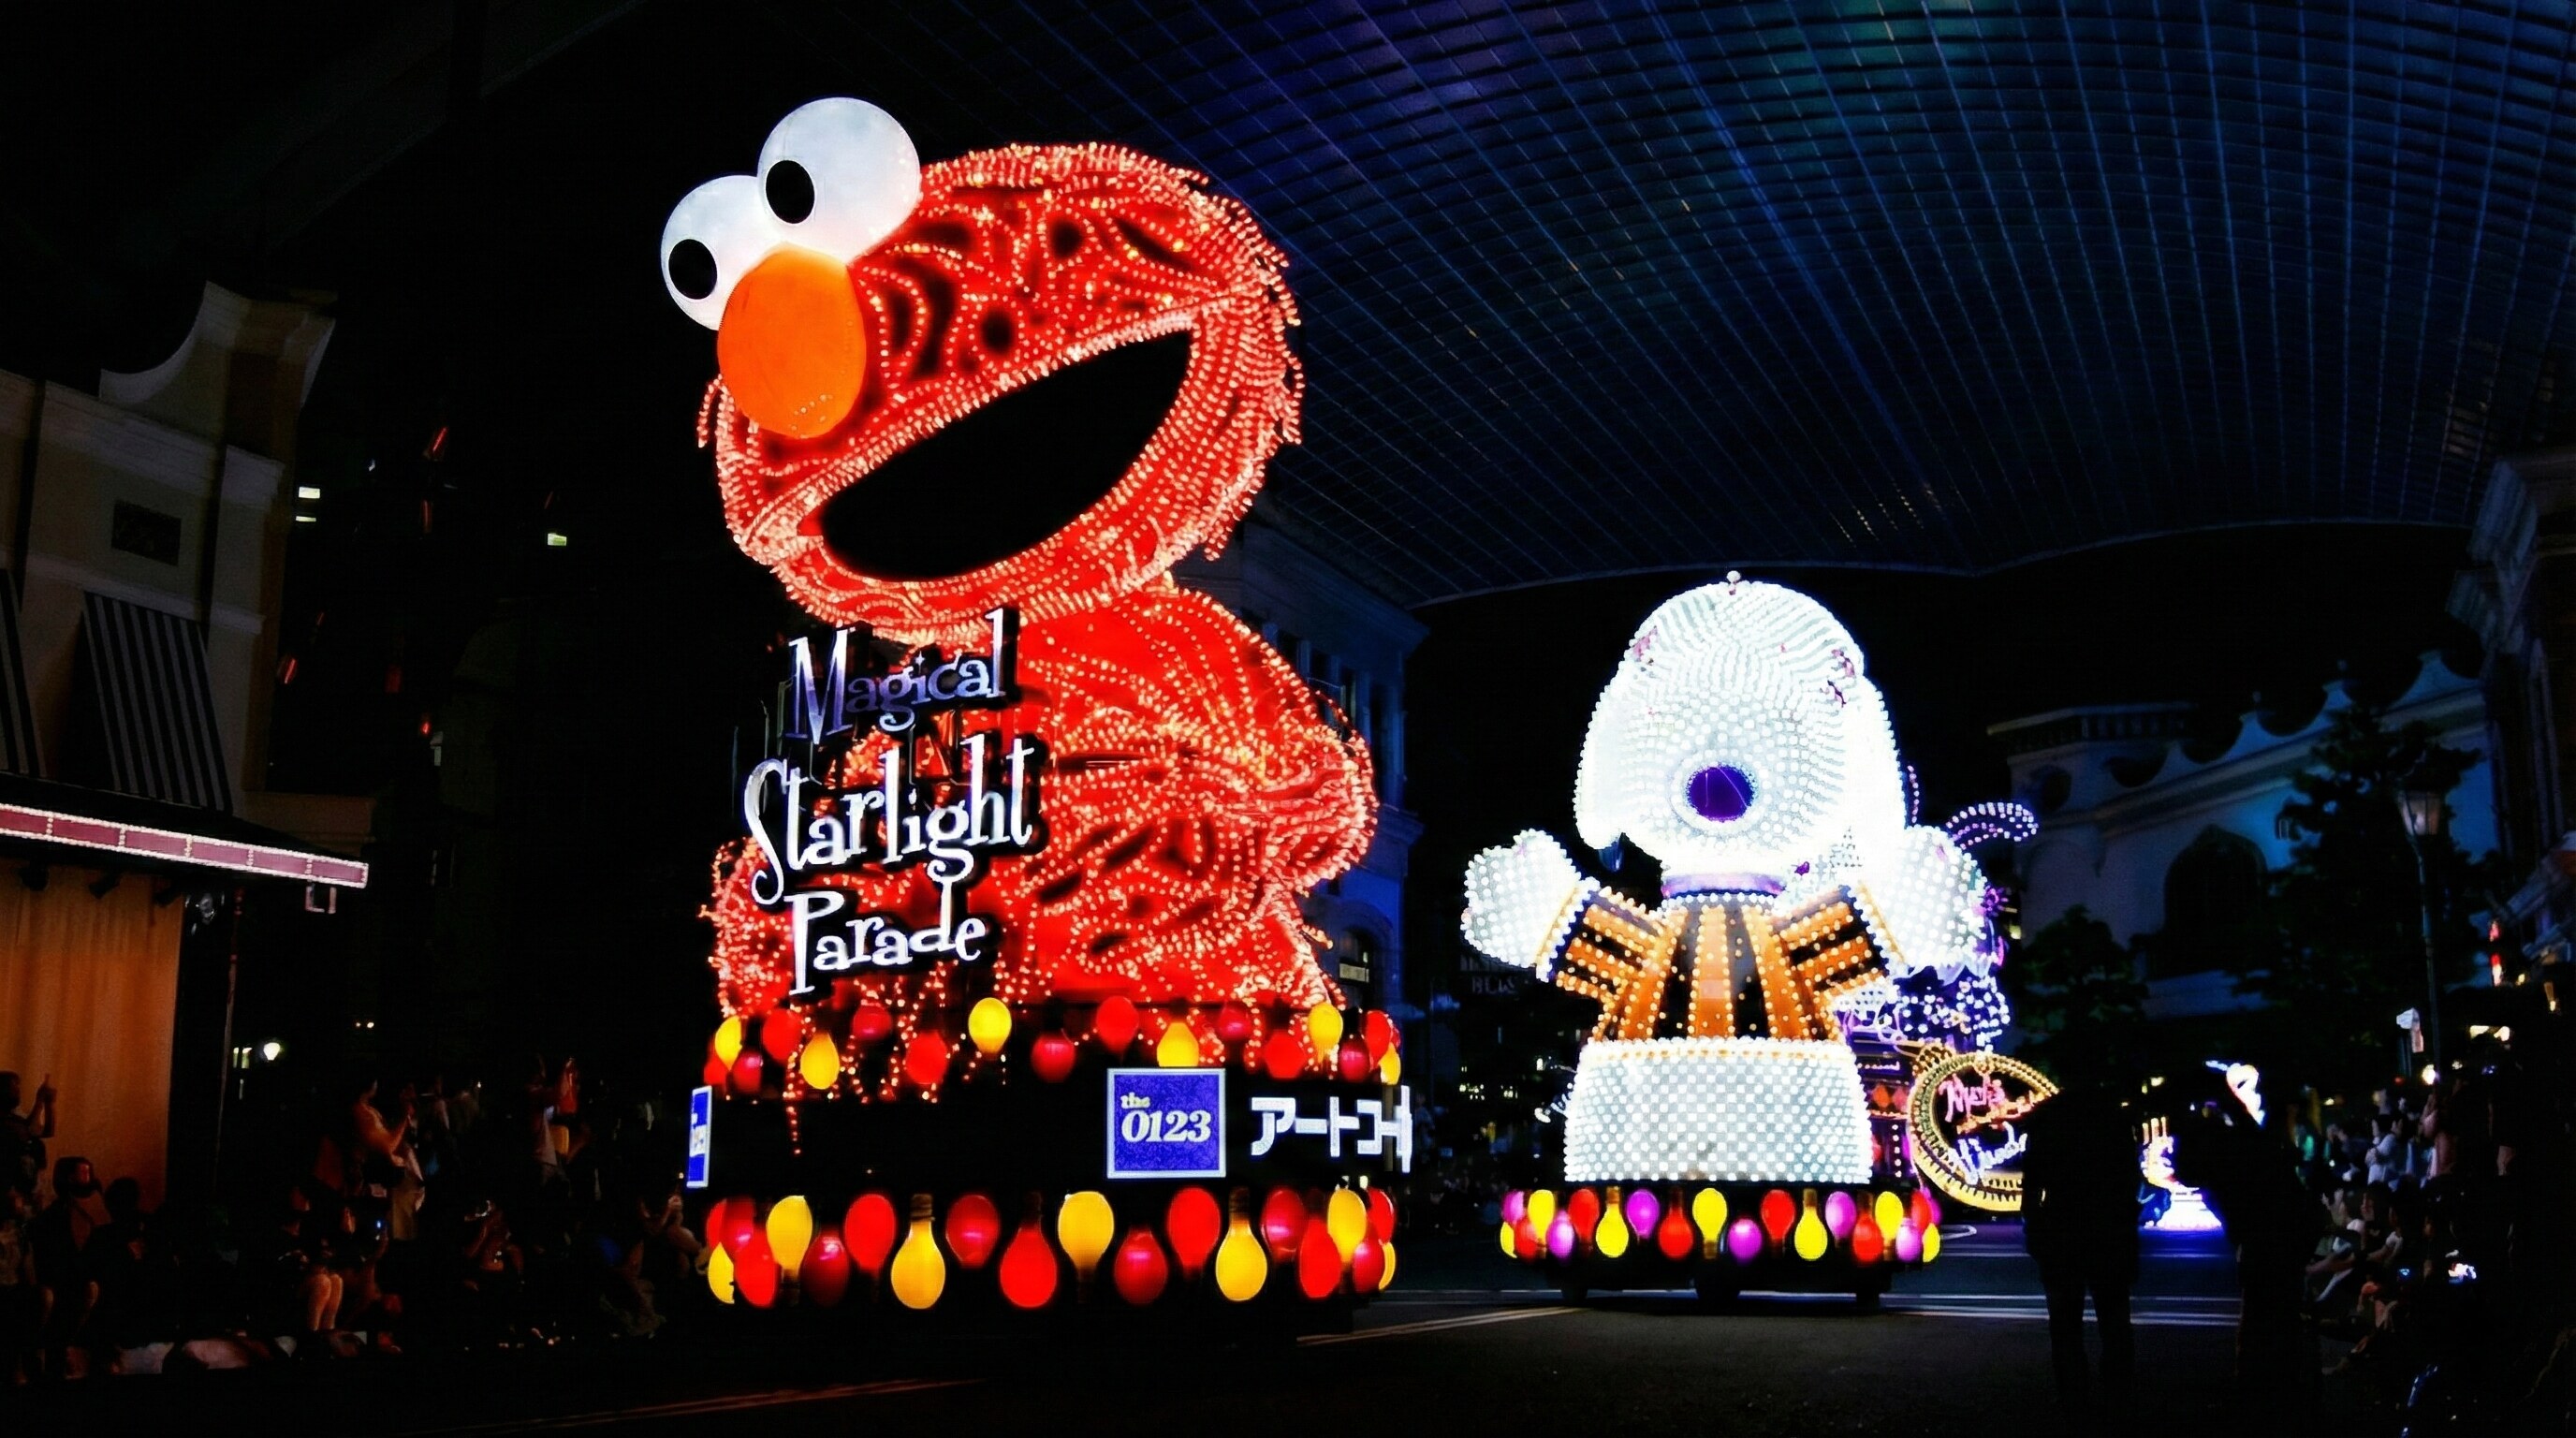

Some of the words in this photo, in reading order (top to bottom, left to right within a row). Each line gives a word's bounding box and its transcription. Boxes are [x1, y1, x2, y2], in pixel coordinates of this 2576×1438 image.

[785, 608, 1006, 745] Magical
[744, 733, 1035, 905] Starlight
[783, 881, 986, 996] Parade
[1120, 1092, 1151, 1109] the
[1121, 1110, 1212, 1142] 0123
